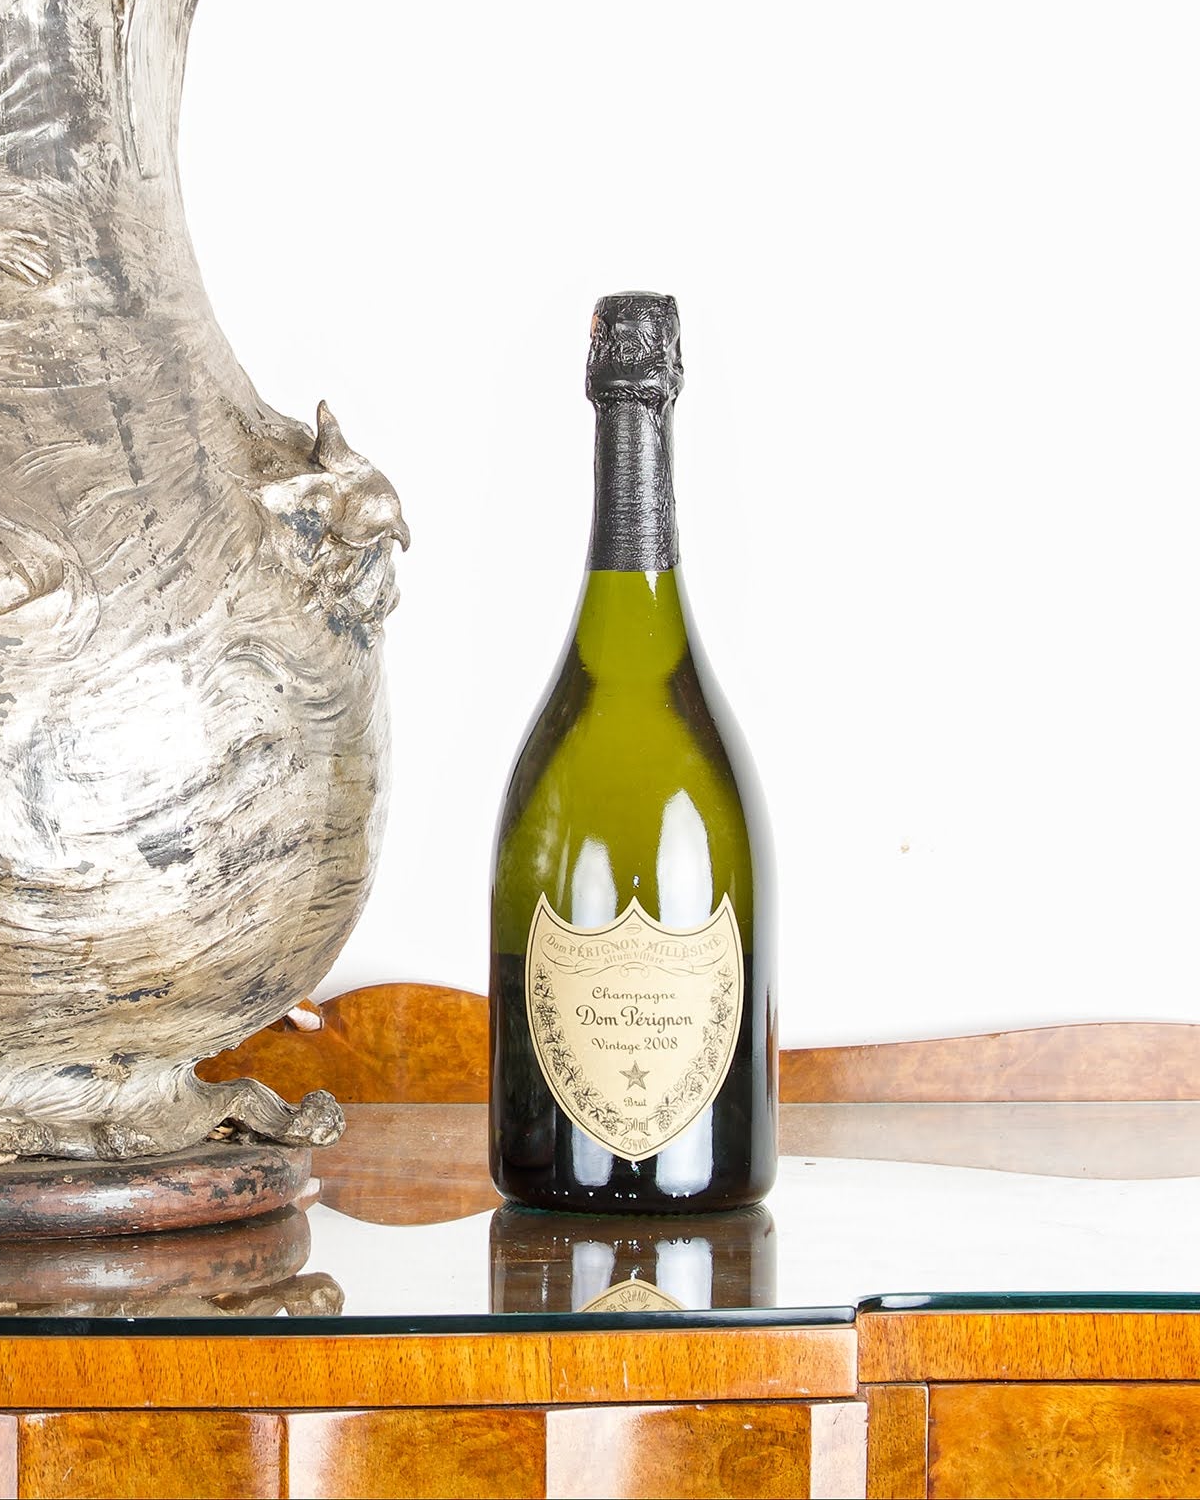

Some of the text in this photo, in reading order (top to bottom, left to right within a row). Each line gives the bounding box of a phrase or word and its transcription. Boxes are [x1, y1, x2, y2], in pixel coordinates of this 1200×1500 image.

[546, 935, 568, 953] Dom
[592, 986, 677, 1004] Champagne
[575, 1004, 693, 1034] Dom Pérignon
[591, 1037, 678, 1054] Vintage 2008
[623, 1097, 647, 1107] Brut
